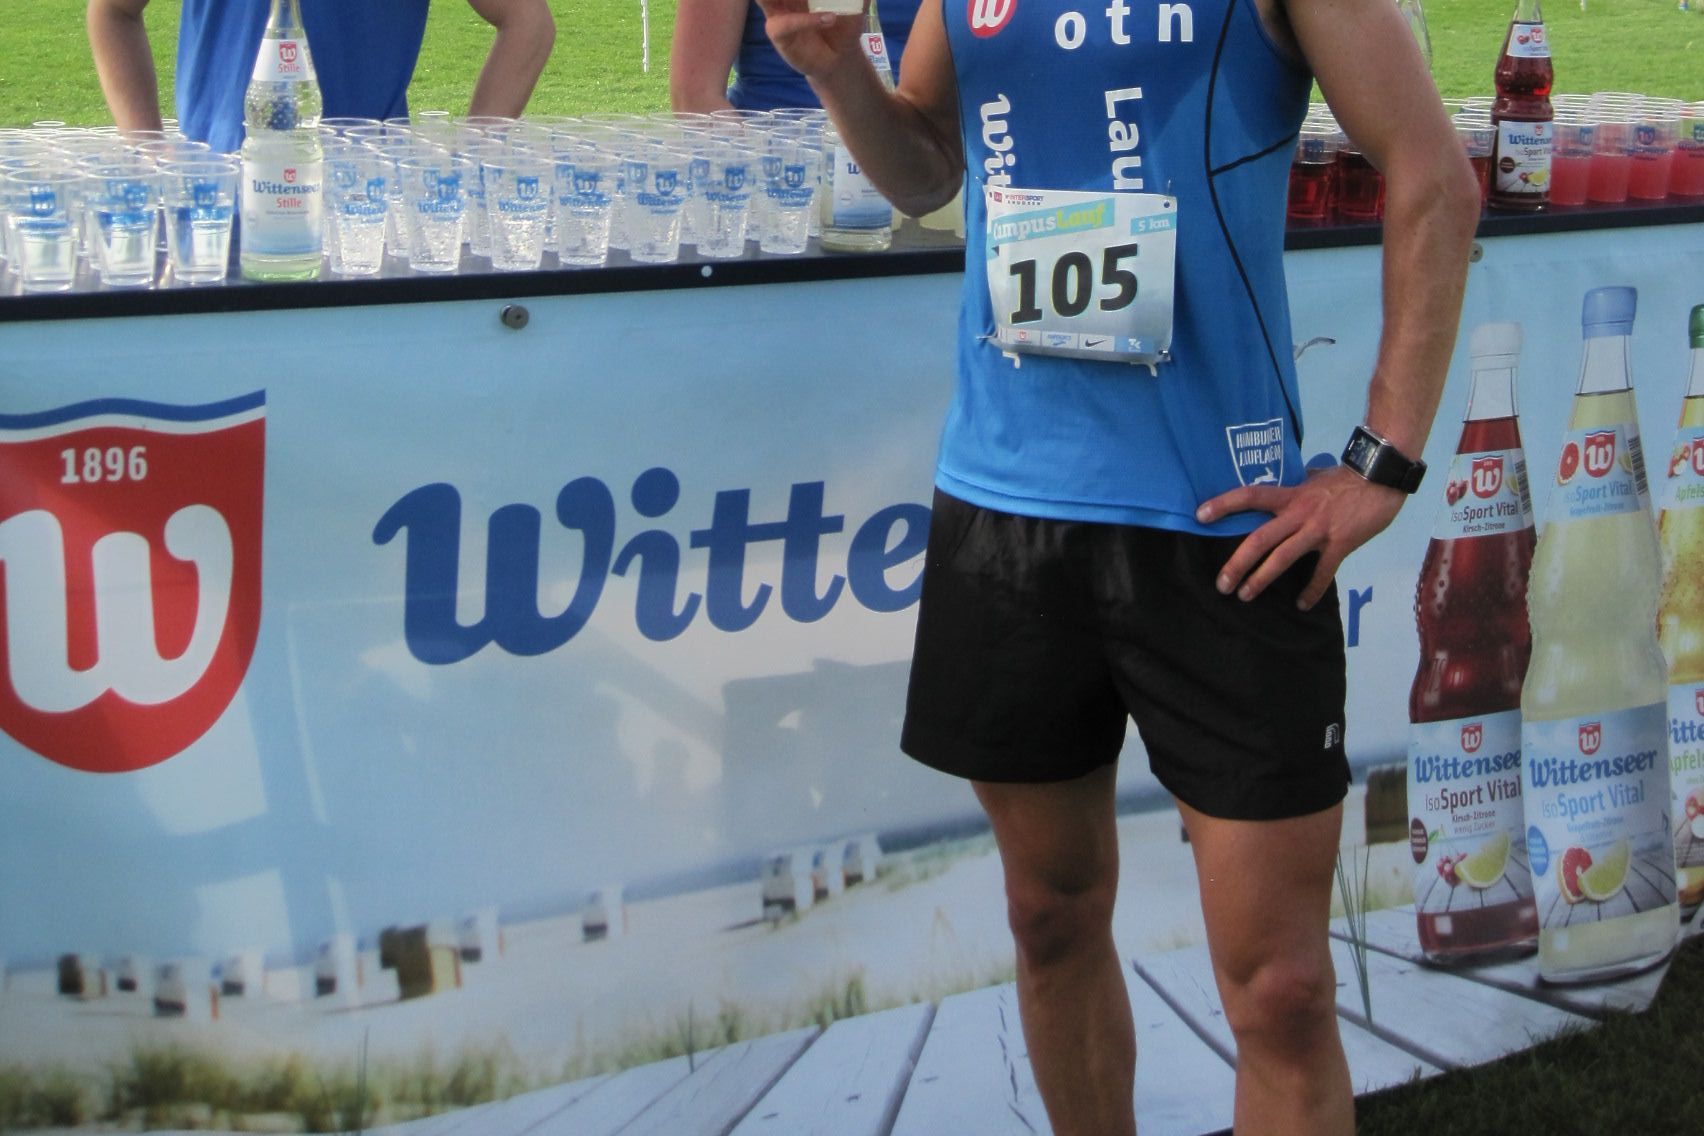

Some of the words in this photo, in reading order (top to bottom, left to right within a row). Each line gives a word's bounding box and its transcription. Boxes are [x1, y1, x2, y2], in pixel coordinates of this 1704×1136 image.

[277, 63, 301, 73] Stille
[276, 198, 302, 208] Stille
[1138, 220, 1146, 232] 5
[1149, 217, 1170, 230] km
[1010, 243, 1138, 325] 105
[59, 446, 148, 484] 1896
[1609, 479, 1632, 496] Vital
[1496, 501, 1518, 516] Vital
[1529, 749, 1657, 788] Wittenseer
[1487, 774, 1522, 802] Vital
[1608, 779, 1645, 808] Vital
